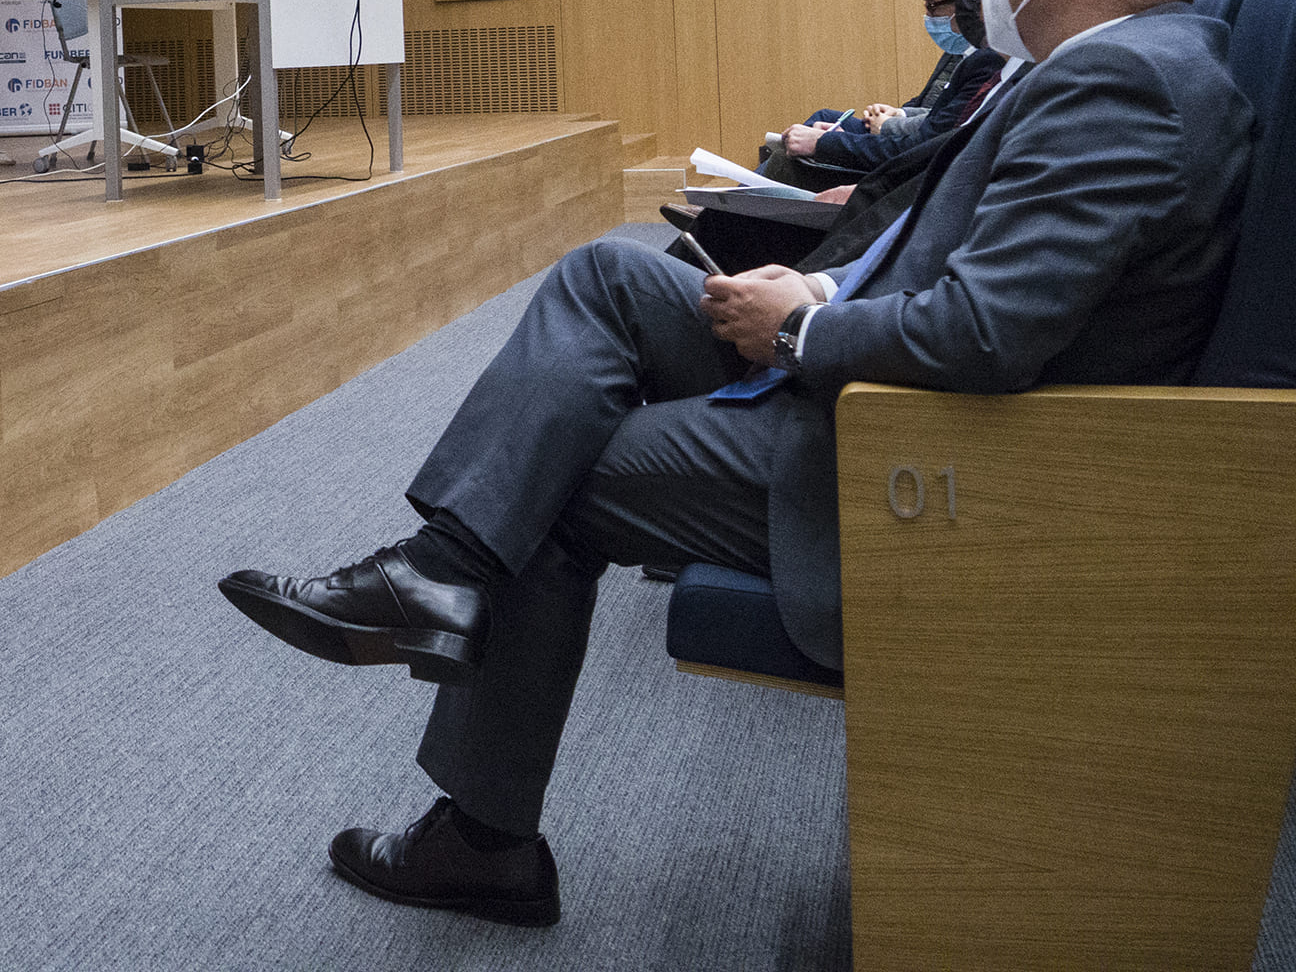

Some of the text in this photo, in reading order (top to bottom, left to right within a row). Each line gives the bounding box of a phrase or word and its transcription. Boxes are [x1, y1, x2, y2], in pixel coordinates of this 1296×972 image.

[23, 19, 55, 29] FIDBA
[25, 79, 68, 88] FIDBAN
[889, 465, 956, 519] 01
